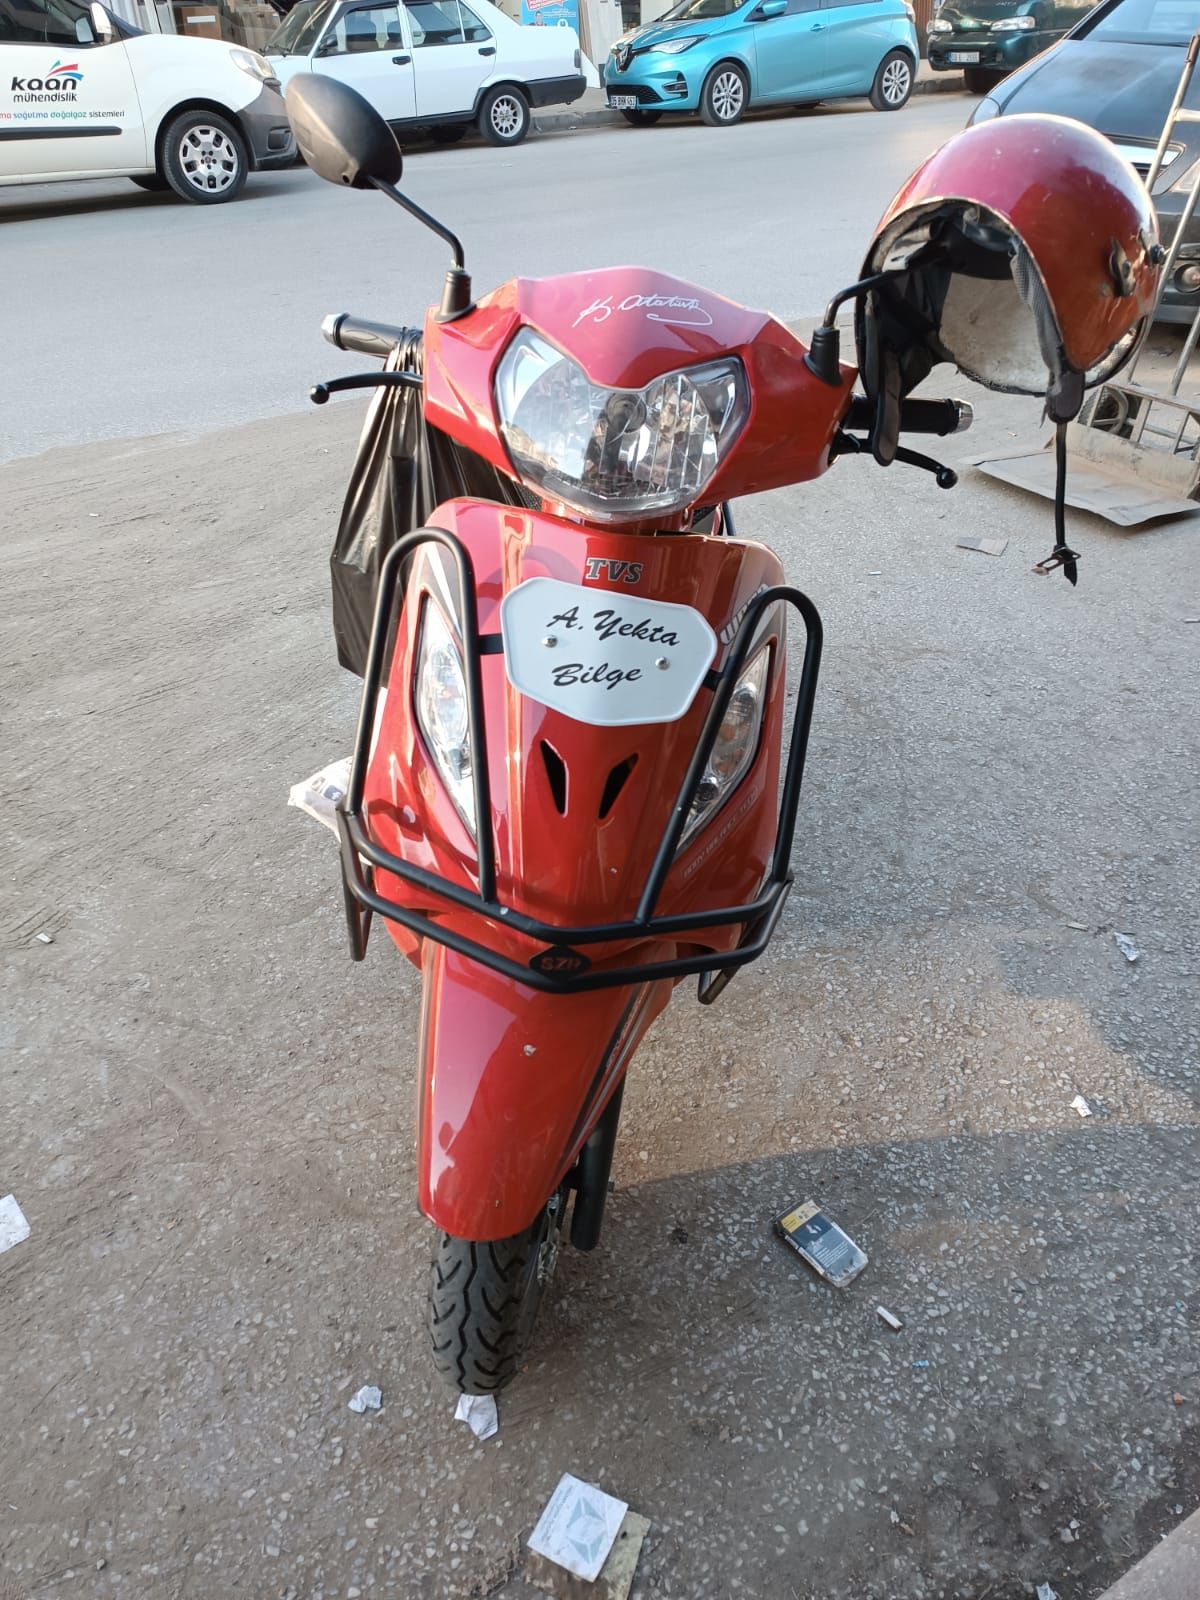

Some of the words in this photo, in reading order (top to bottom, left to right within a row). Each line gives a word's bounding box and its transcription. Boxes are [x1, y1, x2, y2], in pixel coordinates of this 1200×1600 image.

[11, 76, 77, 91] kaan
[13, 92, 77, 103] mühendislik
[13, 111, 49, 120] soğutma
[50, 110, 87, 120] doğalgaz
[89, 109, 125, 118] sistemleri
[585, 557, 643, 584] TVS
[546, 605, 583, 630] A.
[593, 609, 680, 646] Yekta
[551, 662, 643, 690] Bilge
